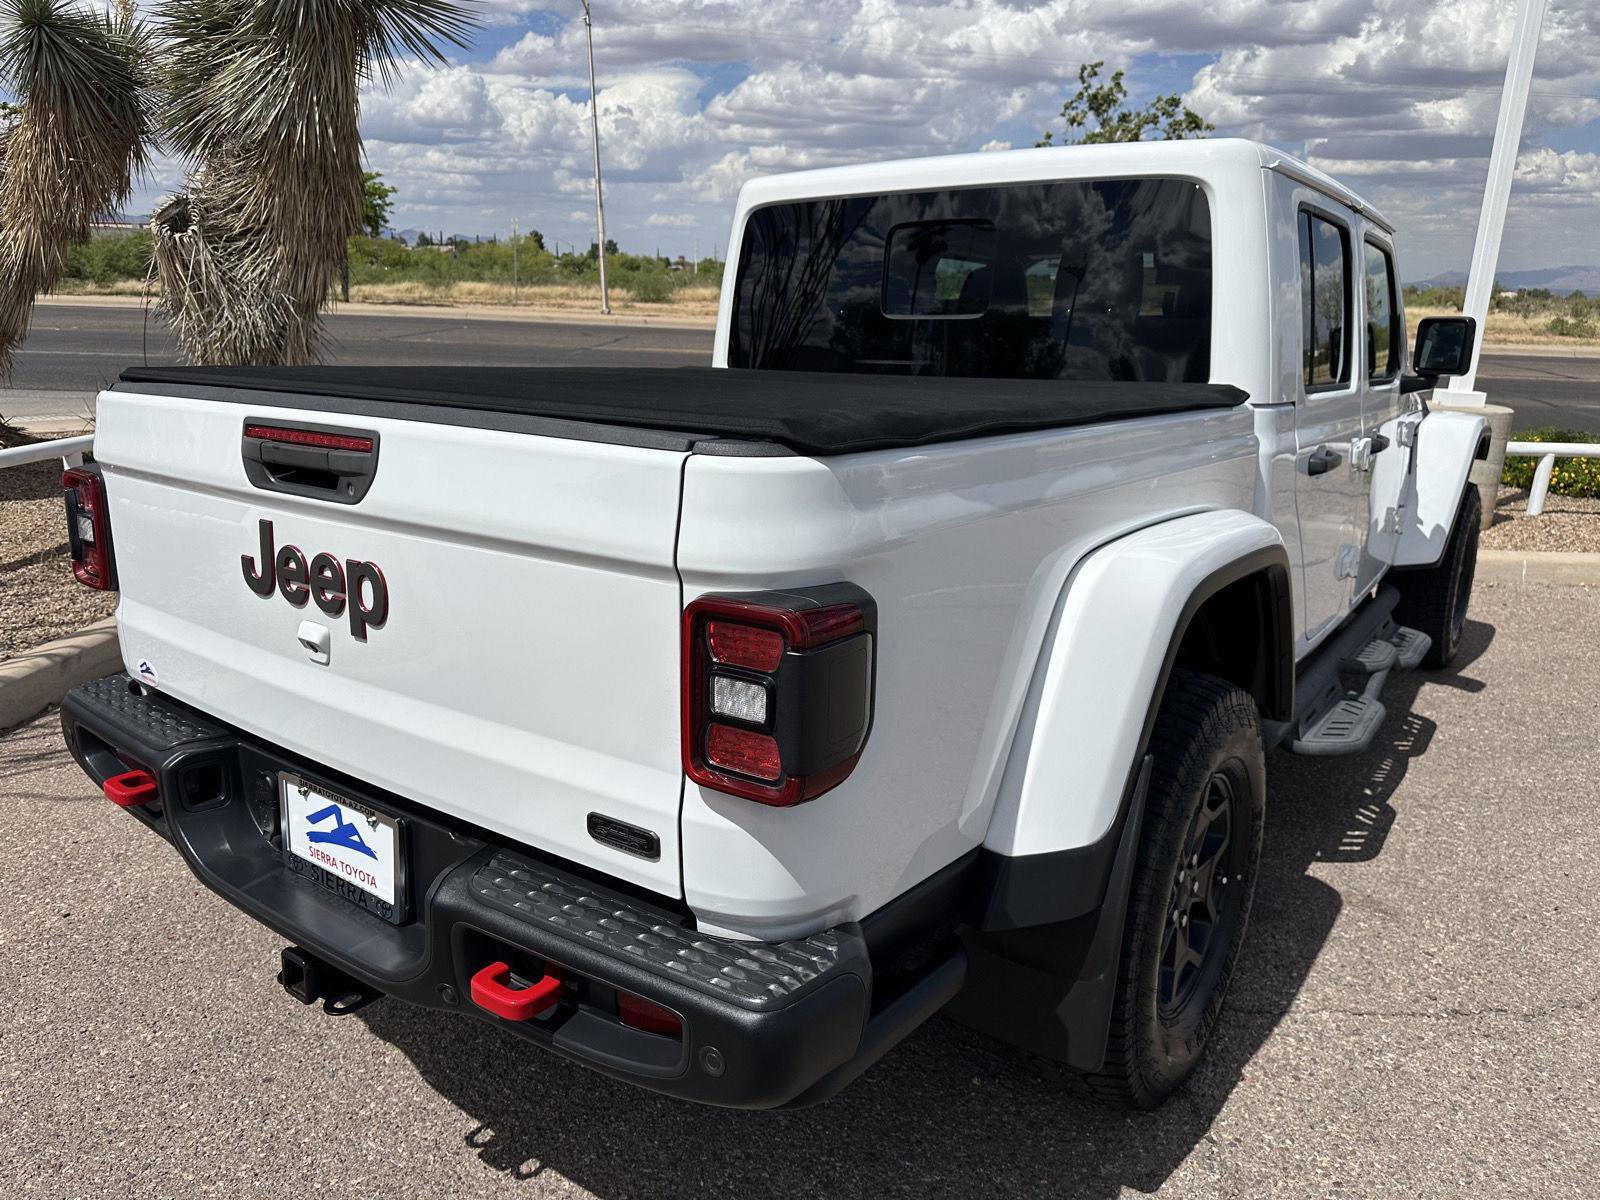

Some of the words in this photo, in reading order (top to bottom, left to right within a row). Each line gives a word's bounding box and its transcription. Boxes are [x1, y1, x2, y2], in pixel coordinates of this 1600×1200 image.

[241, 519, 389, 642] Jeep
[299, 779, 376, 817] SIERRATOYOTA-AZ.COM
[309, 846, 338, 869] SIERRA
[340, 860, 377, 889] TOYOTA
[311, 864, 367, 907] SIERRA
